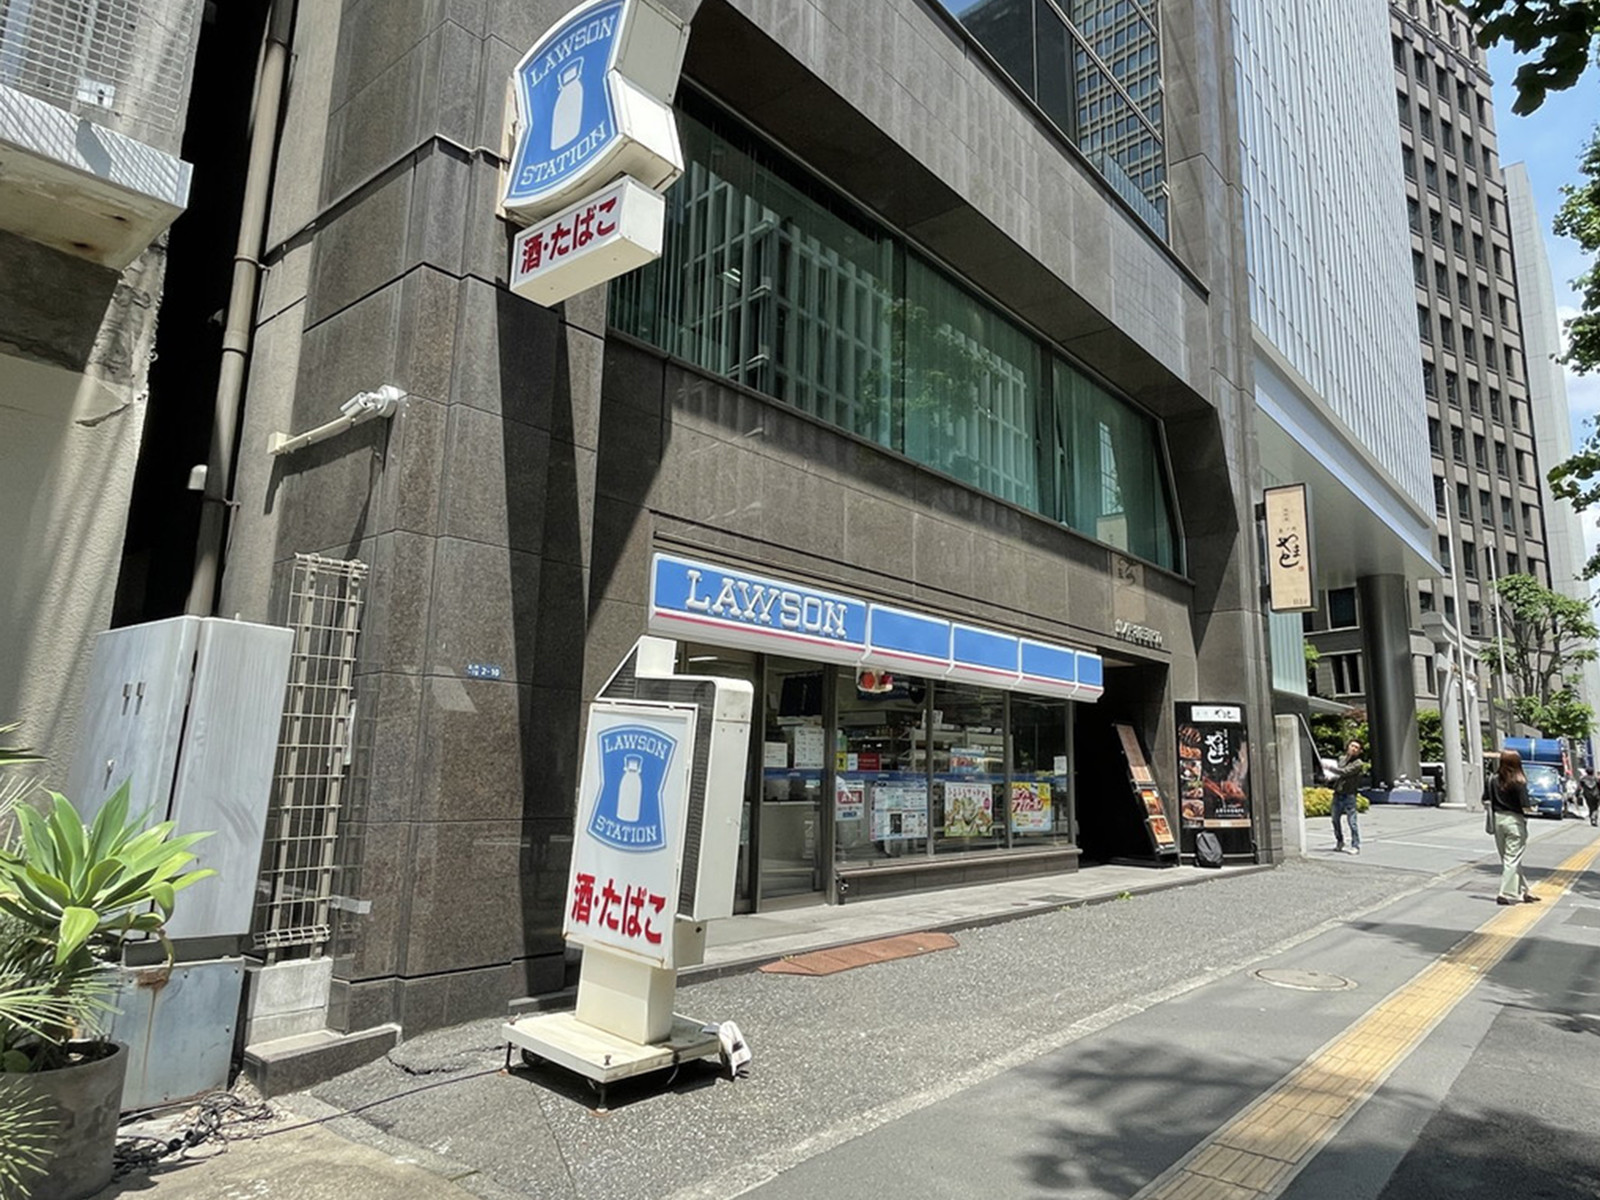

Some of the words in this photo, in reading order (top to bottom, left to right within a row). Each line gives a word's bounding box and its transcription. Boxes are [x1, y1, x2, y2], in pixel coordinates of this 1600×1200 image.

[529, 15, 617, 88] LAWSON
[520, 121, 607, 187] STATION
[520, 197, 617, 275] 酒・たばこ
[686, 569, 848, 638] LAWSON
[604, 734, 669, 761] LAWSON
[595, 815, 657, 843] STATION
[571, 872, 666, 944] 酒・たばこ
